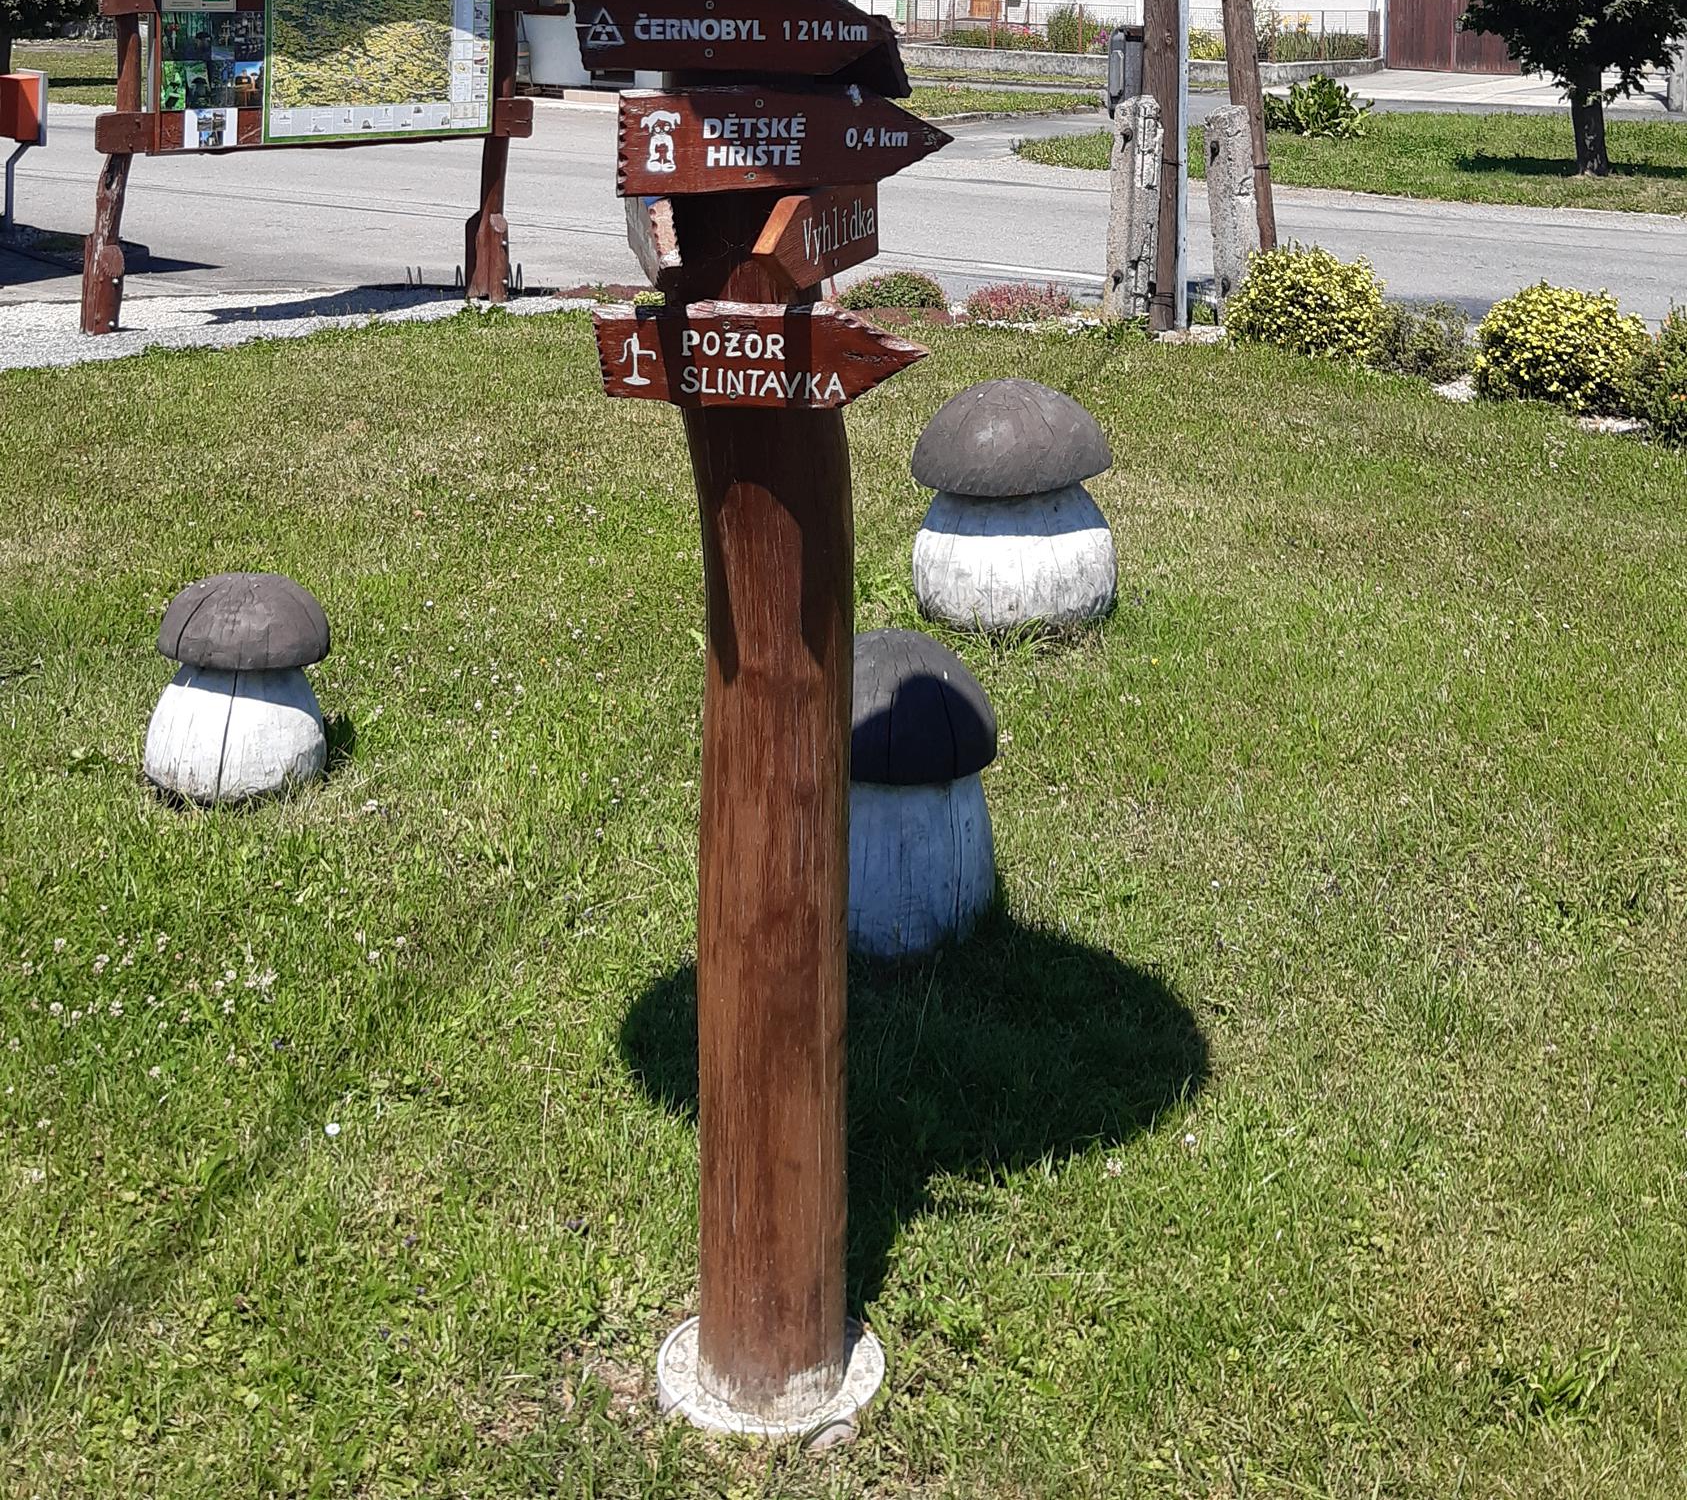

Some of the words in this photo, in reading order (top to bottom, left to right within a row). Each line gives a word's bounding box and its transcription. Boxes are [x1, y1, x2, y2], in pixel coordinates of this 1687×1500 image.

[634, 13, 767, 41] ČERNOBYL
[838, 20, 868, 41] km
[702, 113, 807, 140] DĚTSKÉ
[845, 127, 875, 150] 0,4
[879, 127, 909, 148] km
[706, 140, 802, 168] HŘIŠTĚ
[802, 196, 876, 266] Vyhlídka
[681, 329, 786, 360] POZOR
[680, 365, 847, 400] SLINTAVKA
